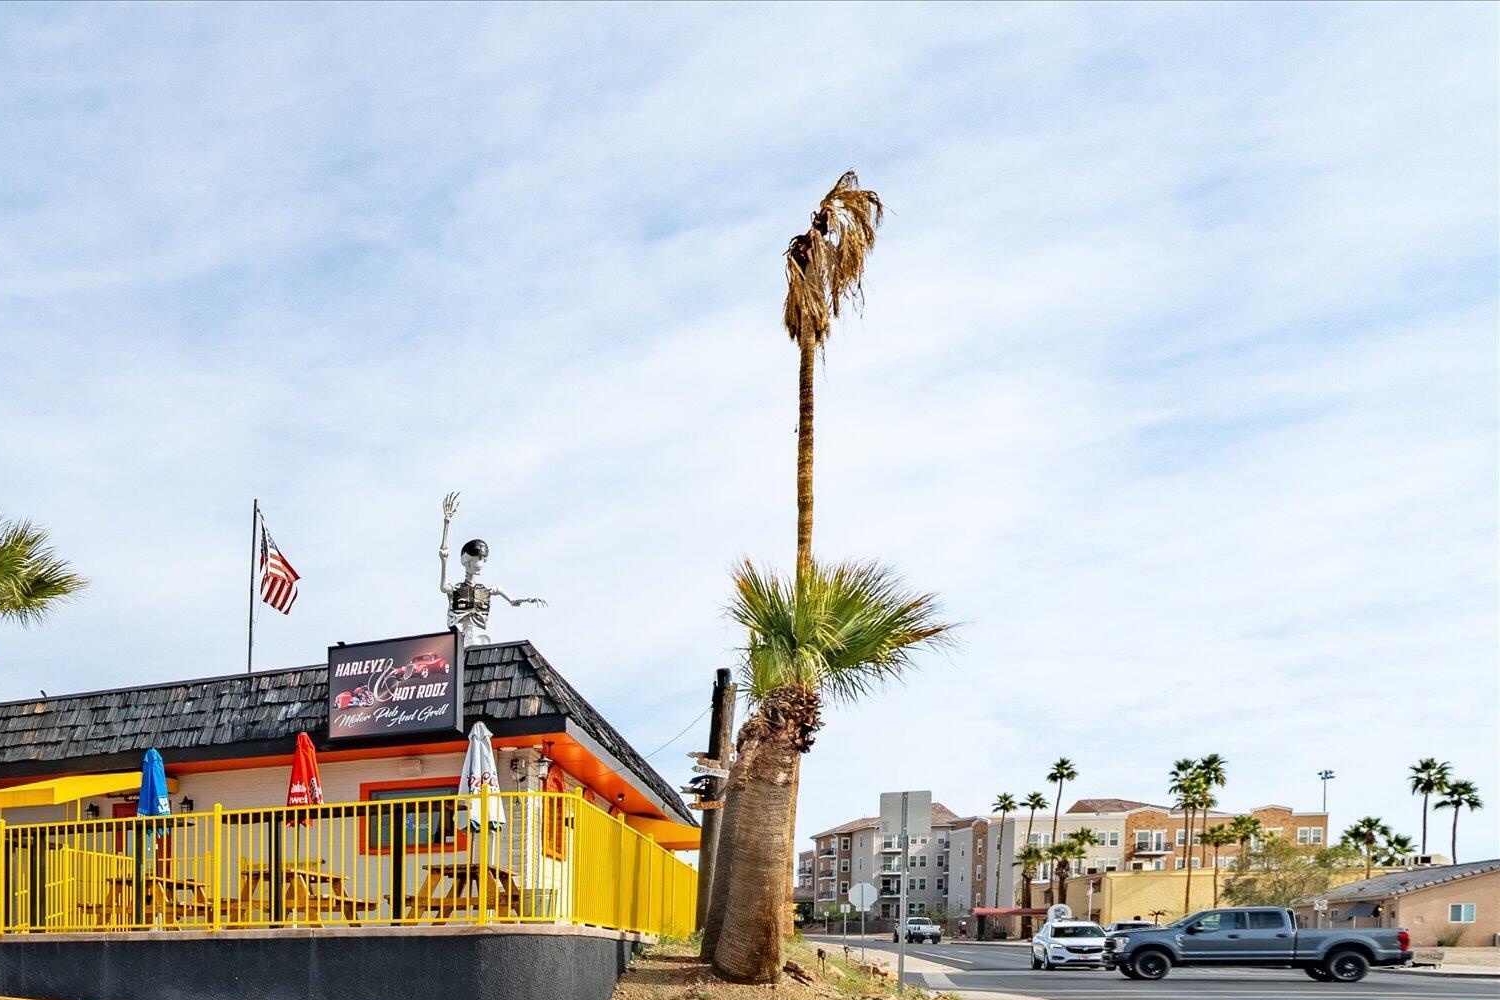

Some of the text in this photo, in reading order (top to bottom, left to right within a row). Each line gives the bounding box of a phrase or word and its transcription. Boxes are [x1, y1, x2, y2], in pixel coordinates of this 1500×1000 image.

[335, 659, 385, 677] HARLEYZ
[392, 682, 449, 701] HOT RODZ
[334, 703, 449, 728] Motor Pub And Grill
